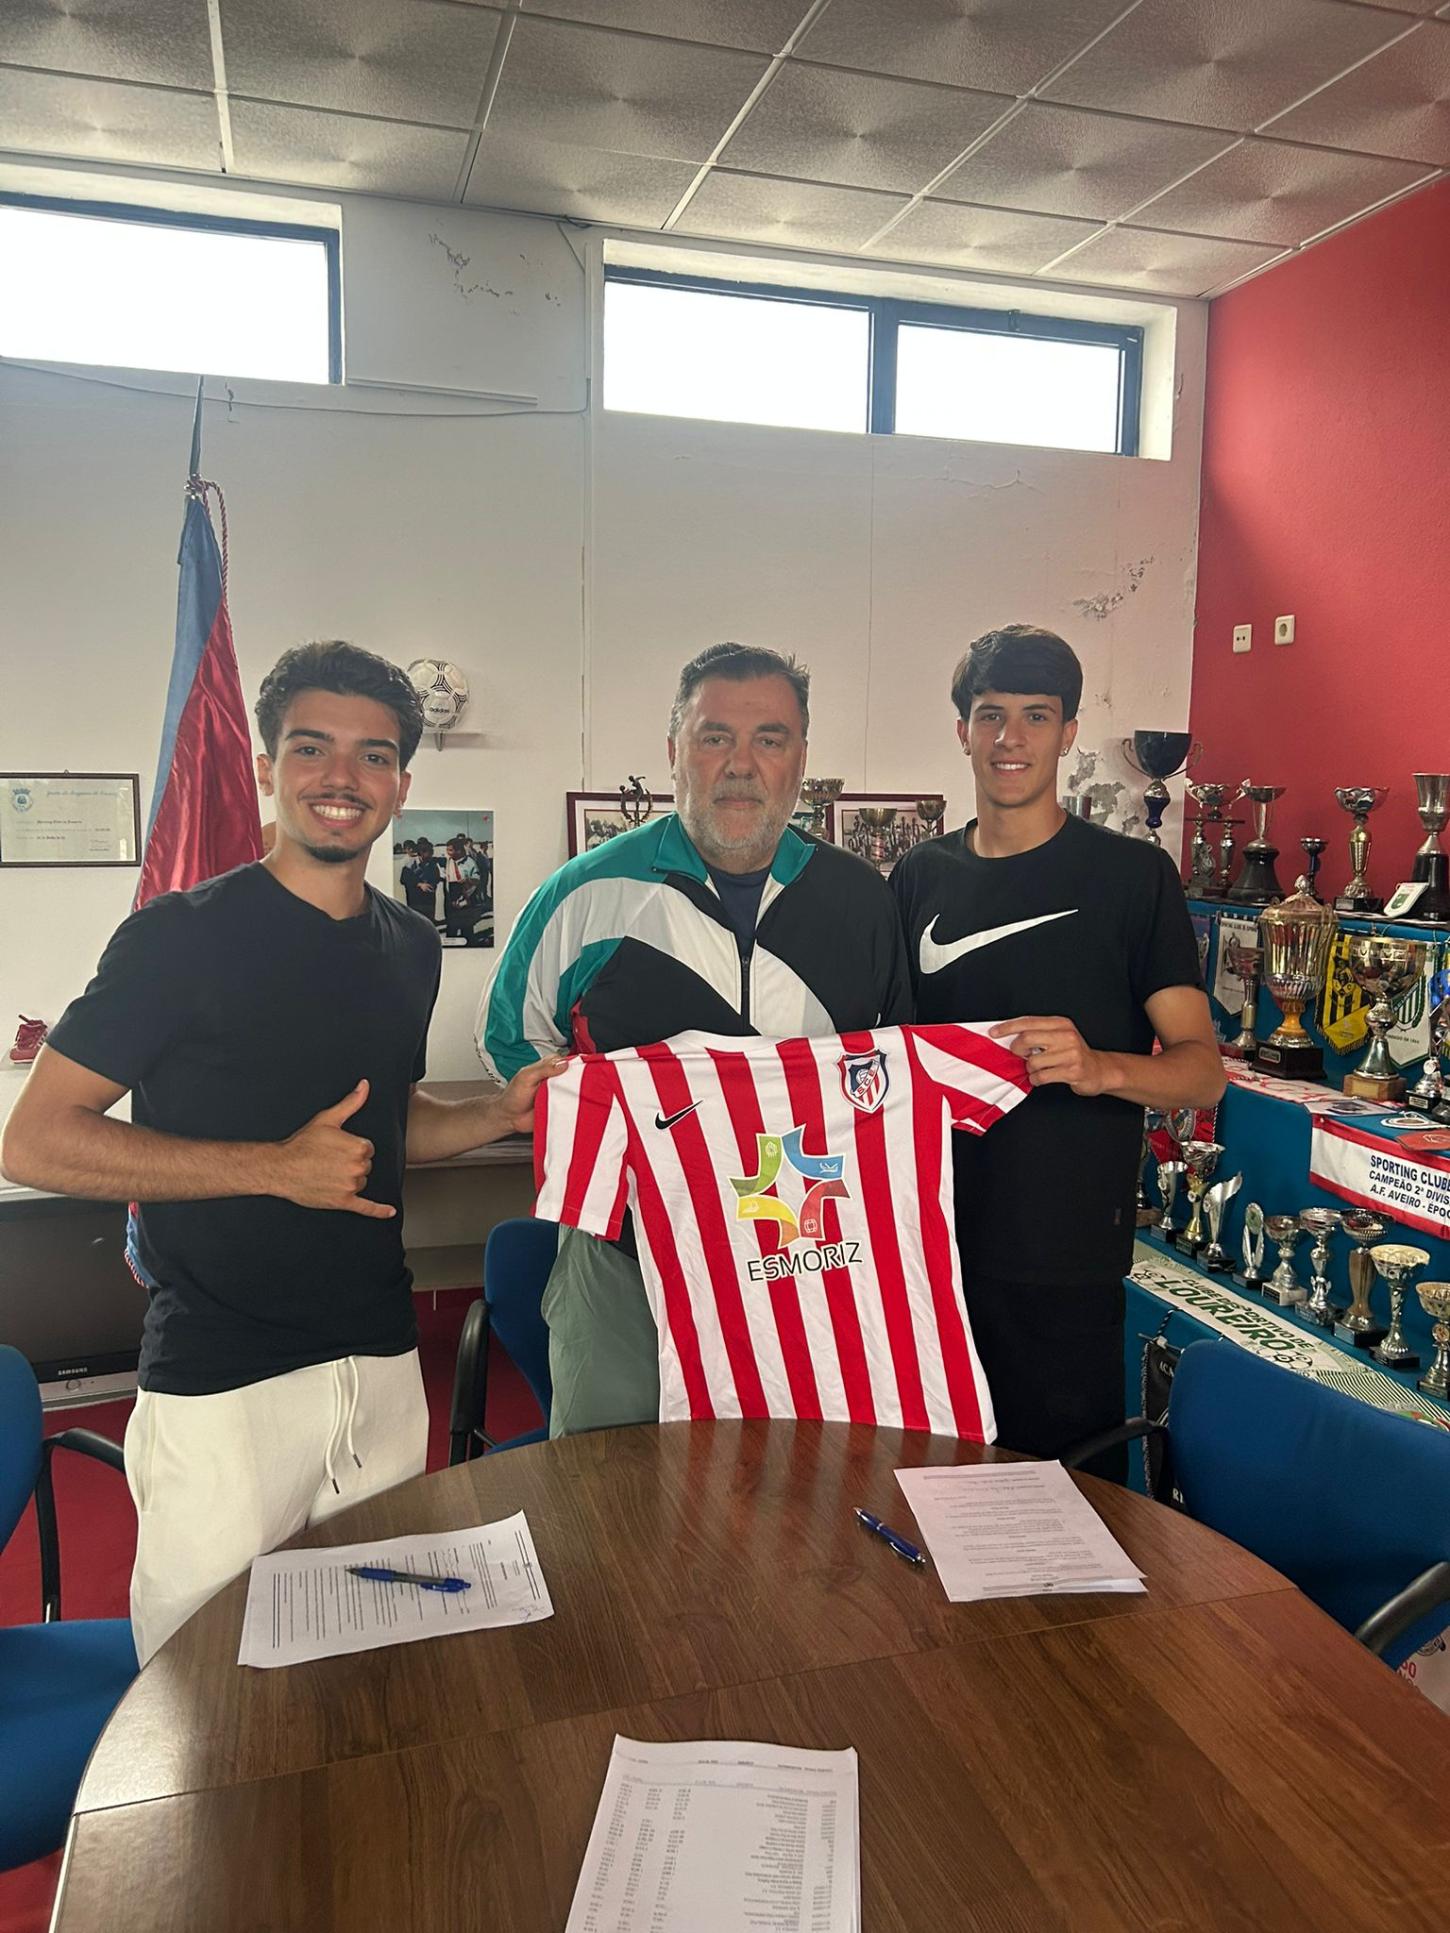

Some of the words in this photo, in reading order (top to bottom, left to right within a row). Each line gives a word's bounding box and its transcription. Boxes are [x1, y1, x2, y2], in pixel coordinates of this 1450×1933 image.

[1370, 1155, 1418, 1182] SPORTING
[1369, 1170, 1413, 1192] CAMPEÃO
[1426, 1189, 1450, 1206] DIVIS
[1370, 1184, 1386, 1197] A.F.
[1388, 1190, 1421, 1208] AVEIRO
[747, 1242, 863, 1282] ESMORIZ
[1154, 1280, 1296, 1350] LOUREIRO
[1288, 1338, 1315, 1349] DE
[57, 1366, 88, 1375] SAMSUNG
